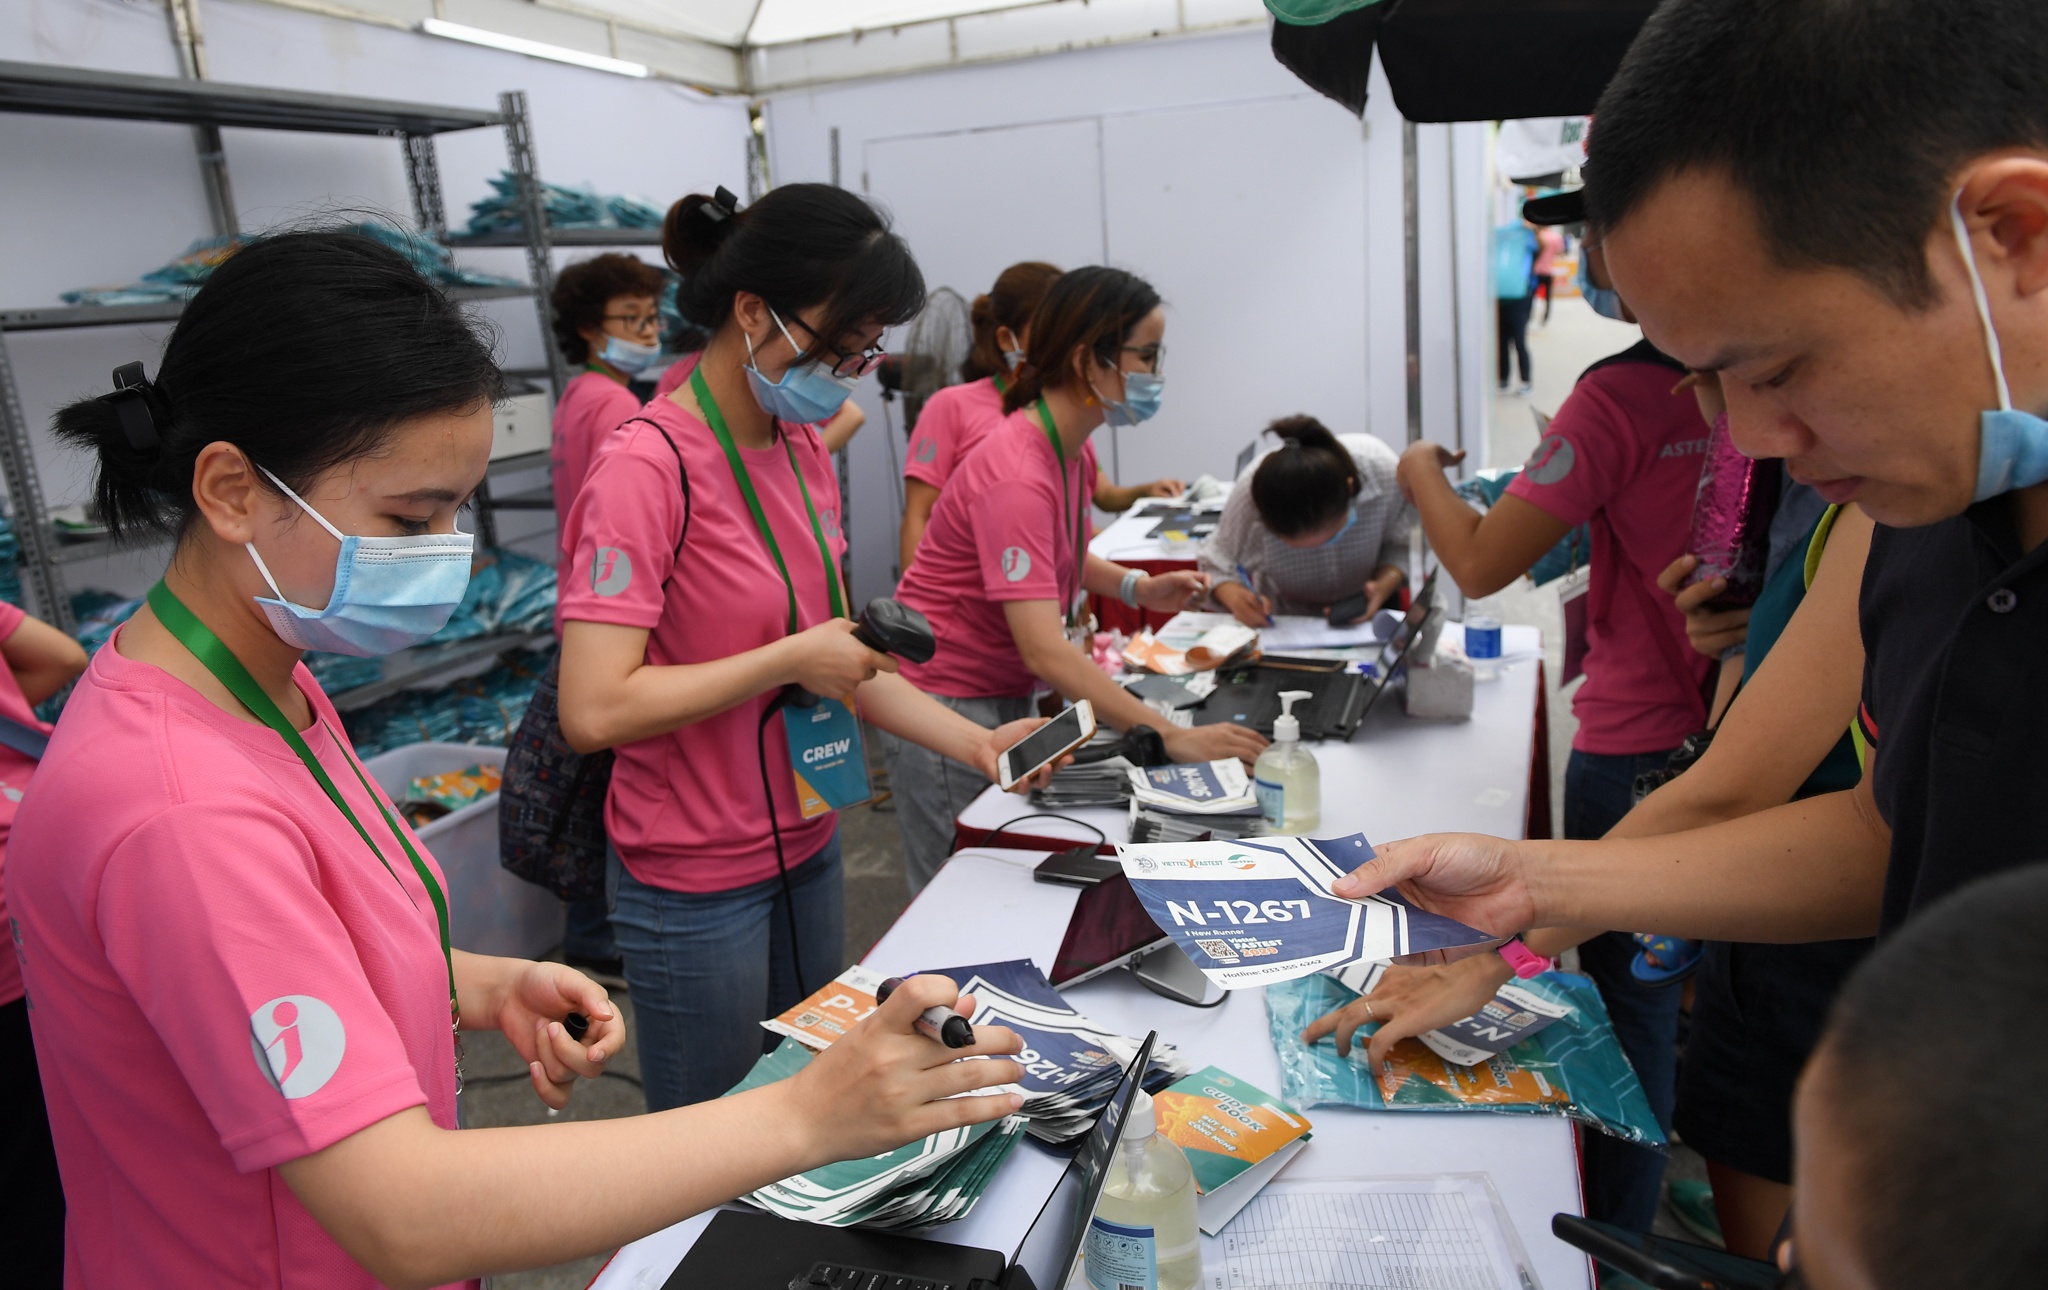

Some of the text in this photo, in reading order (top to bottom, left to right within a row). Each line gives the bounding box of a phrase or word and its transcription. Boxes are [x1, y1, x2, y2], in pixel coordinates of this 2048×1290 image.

[803, 738, 850, 763] CREW
[1166, 900, 1312, 926] N-1267
[1212, 929, 1245, 937] Runner
[1233, 939, 1284, 950] FASTEST
[1240, 947, 1279, 958] 2020
[1222, 959, 1324, 979] Hotline: 033 355 4242
[1203, 1086, 1253, 1114] GUIDE
[1214, 1103, 1268, 1133] BOOK
